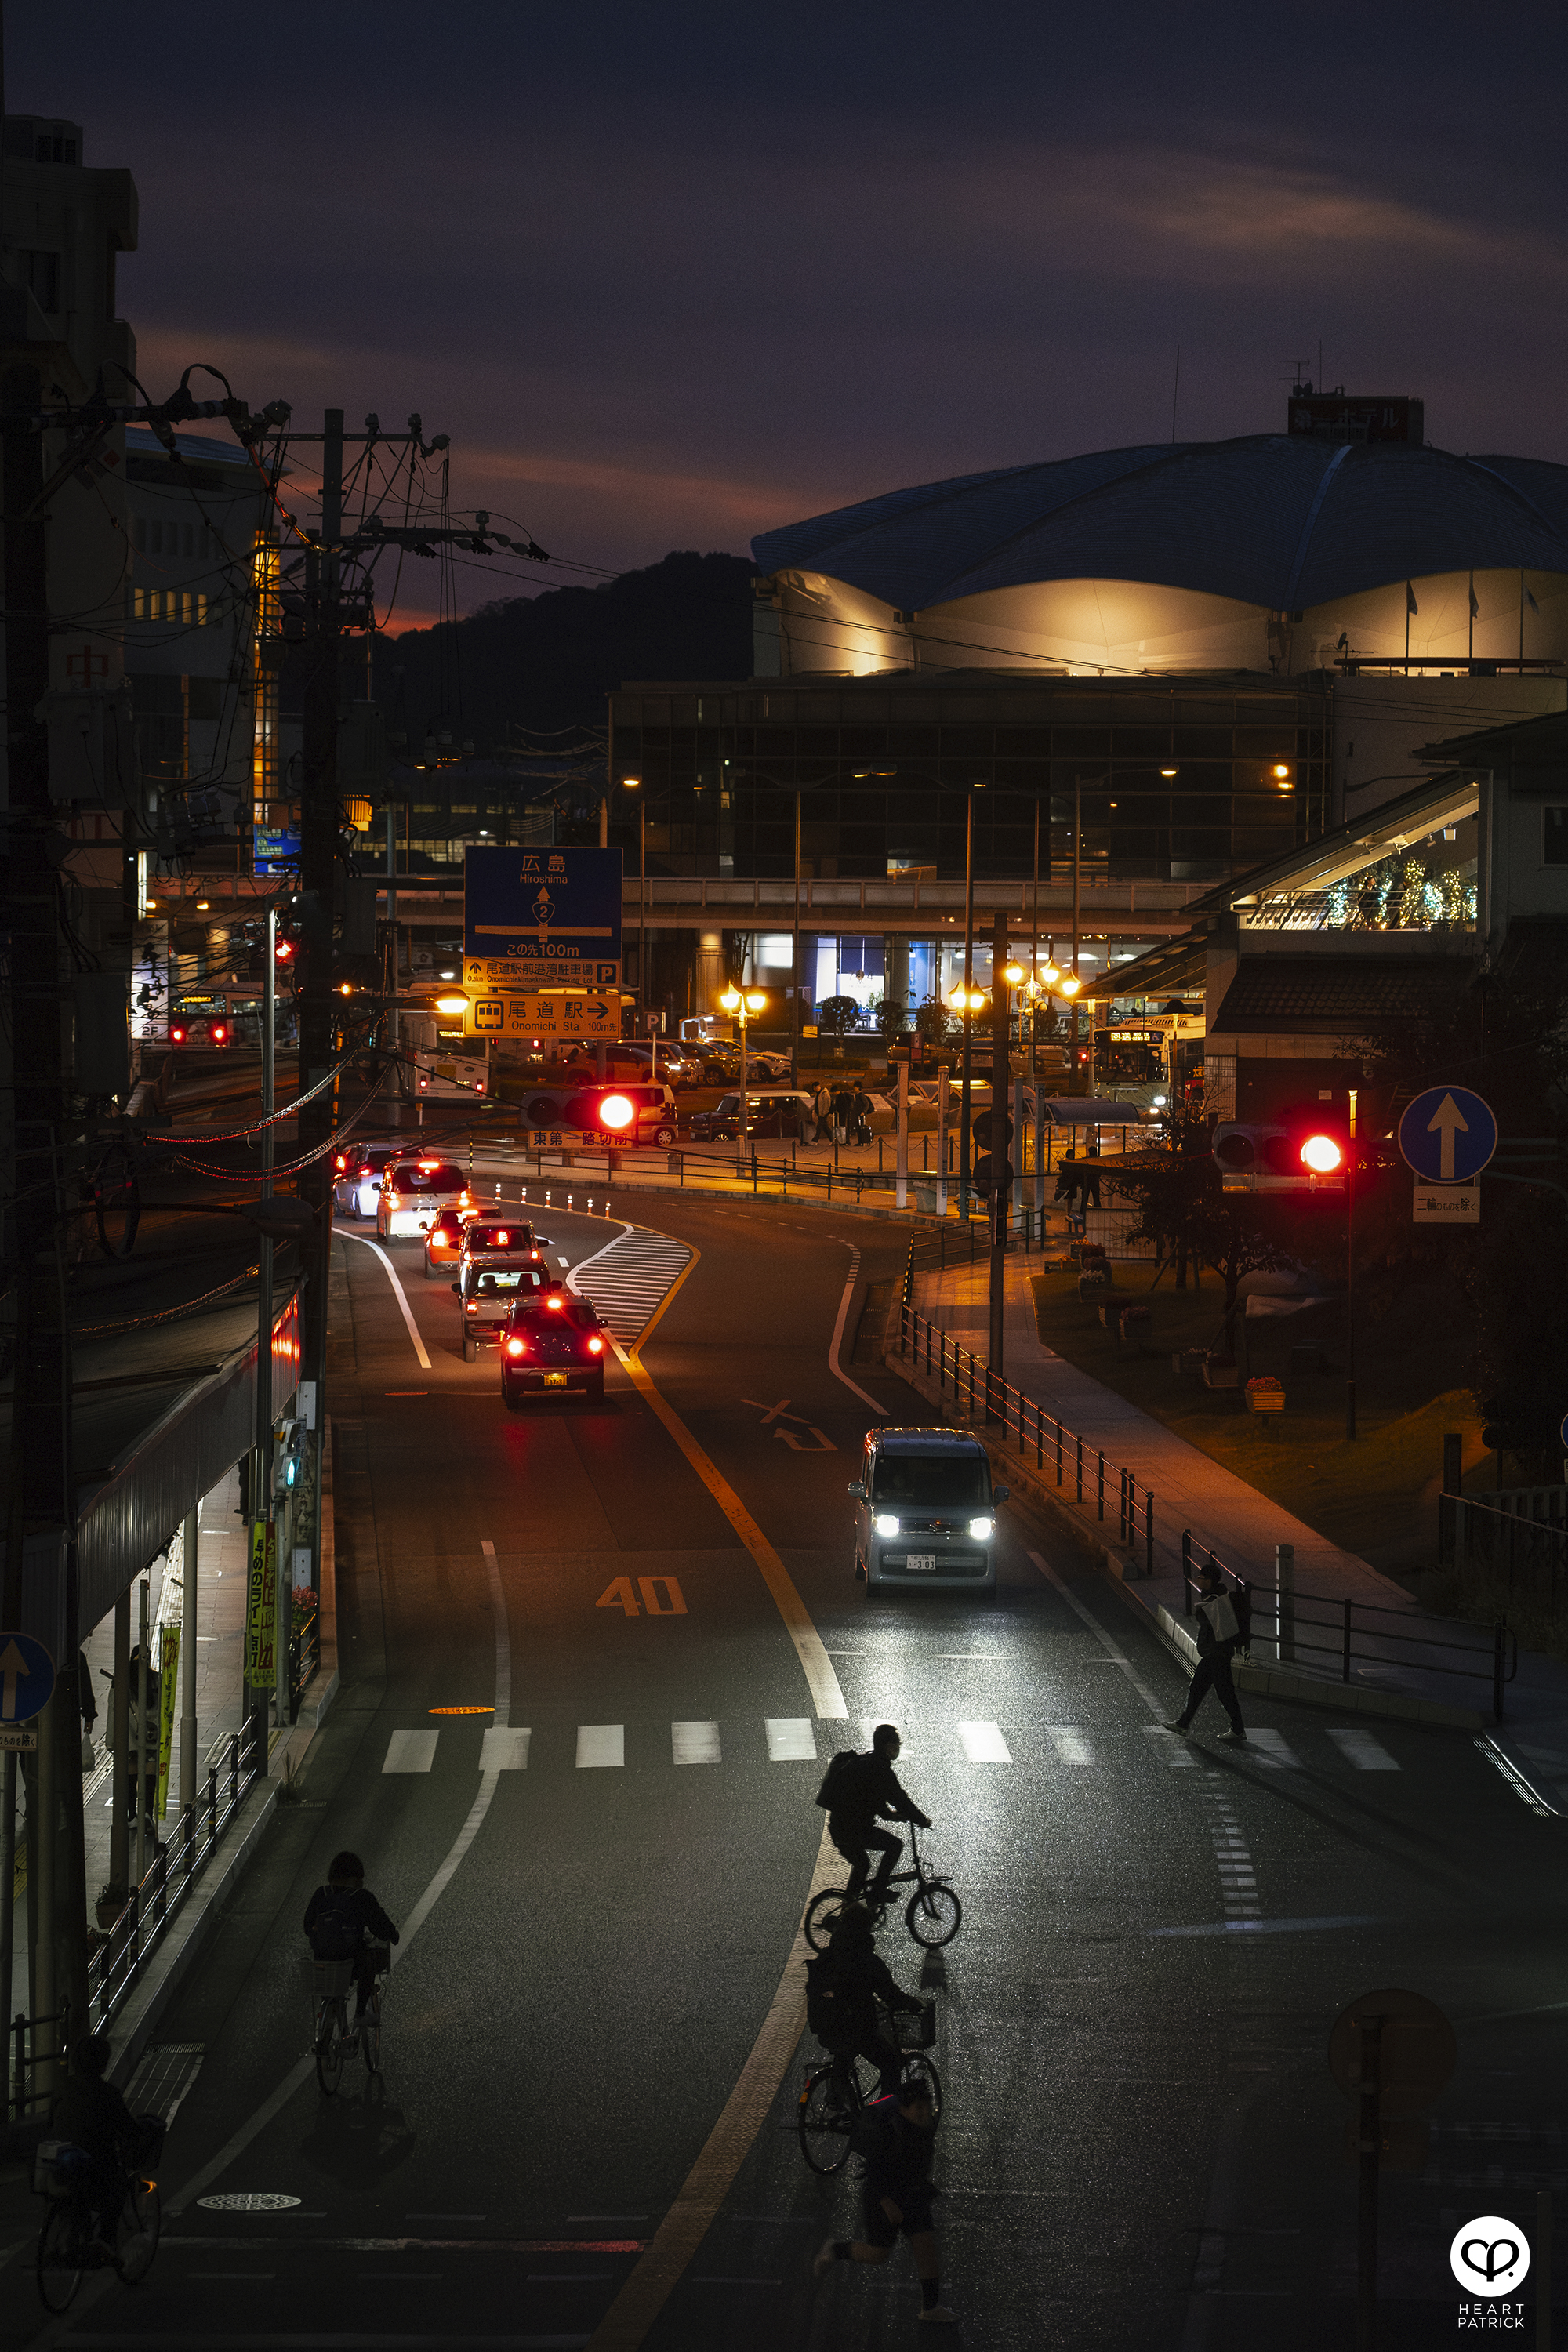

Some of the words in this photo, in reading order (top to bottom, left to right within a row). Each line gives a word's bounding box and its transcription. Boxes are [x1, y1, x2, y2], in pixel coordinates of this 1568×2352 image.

[522, 854, 565, 873] 広島
[520, 873, 568, 884] Hiroshima
[539, 905, 548, 918] 2
[506, 943, 579, 957] この先100m
[486, 962, 593, 976] 尾道駅前港湾駐車場
[508, 1000, 583, 1019] 尾道駅
[511, 1021, 557, 1031] Onomichi
[563, 1022, 579, 1032] Sta
[588, 1022, 617, 1033] 100m先
[647, 1014, 659, 1030] P
[142, 1026, 158, 1036] 2F
[533, 1131, 628, 1146] 東第一踏切前
[1417, 1197, 1476, 1211] 二輪のものを除く
[595, 1576, 688, 1617] 40
